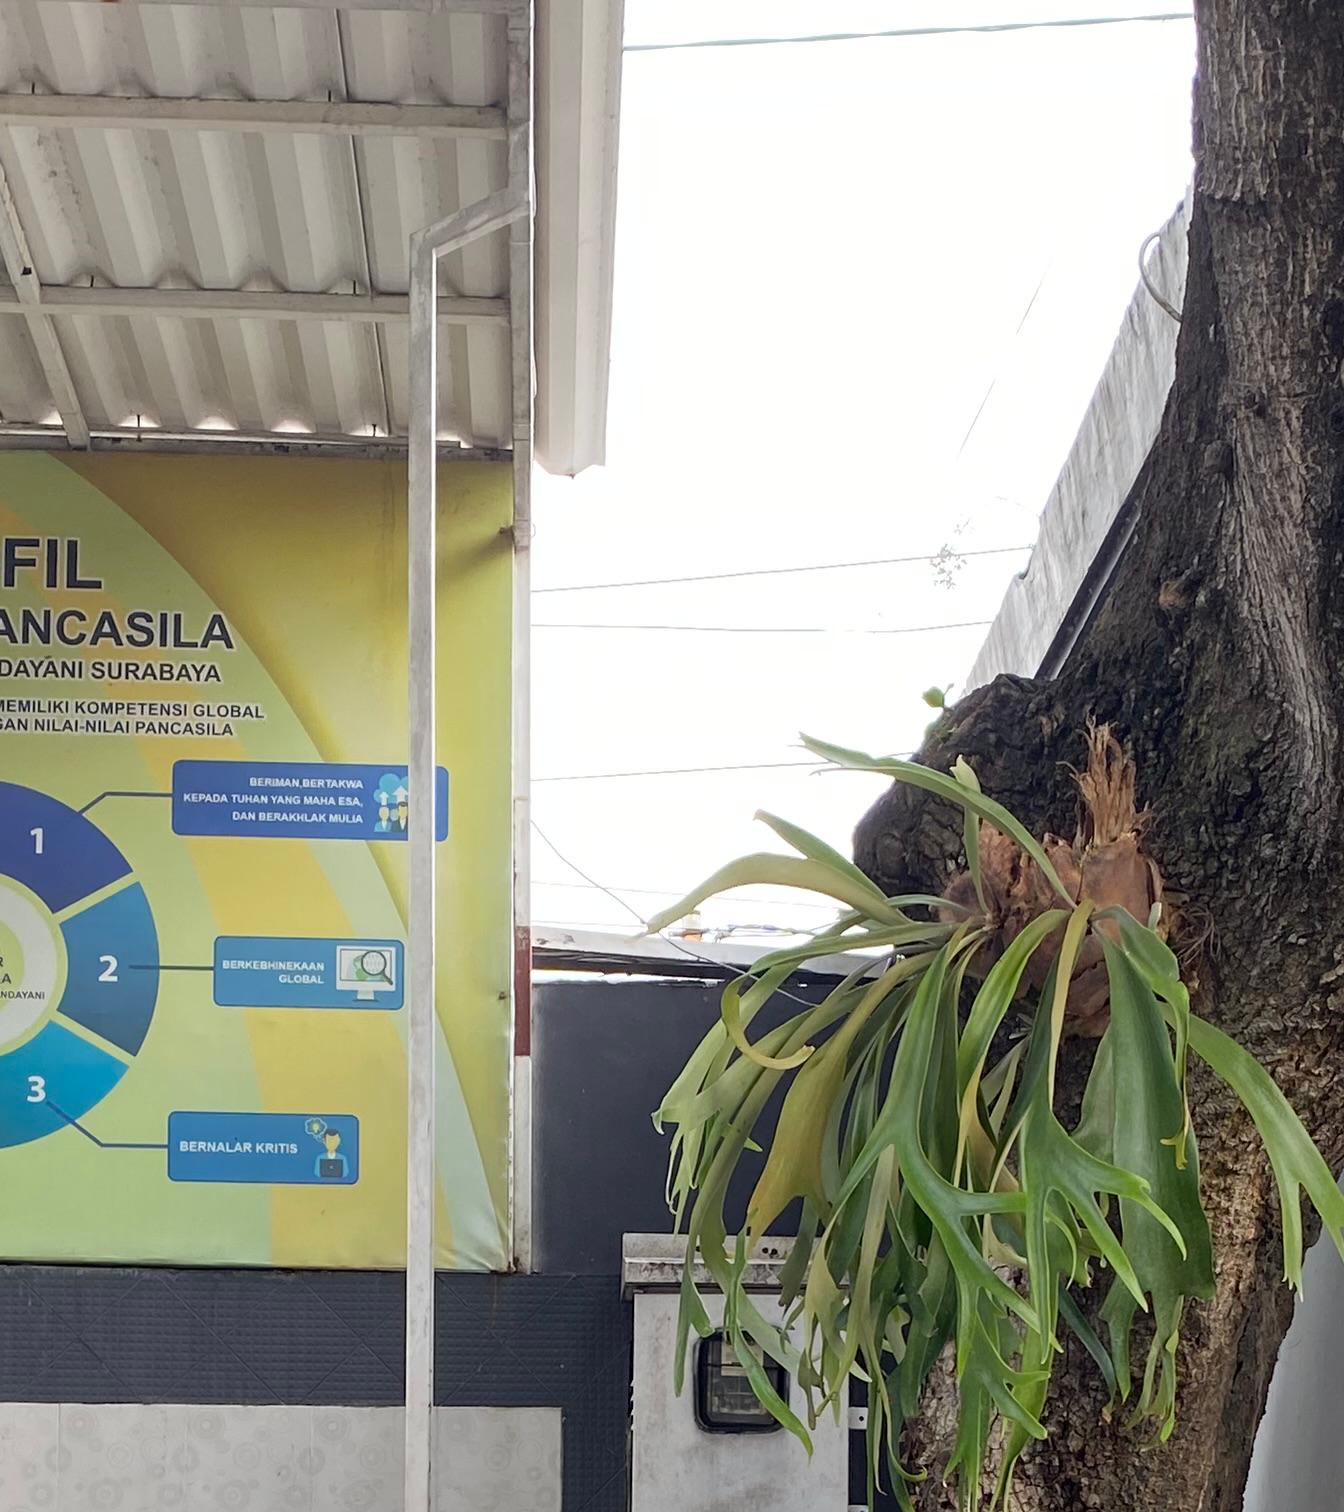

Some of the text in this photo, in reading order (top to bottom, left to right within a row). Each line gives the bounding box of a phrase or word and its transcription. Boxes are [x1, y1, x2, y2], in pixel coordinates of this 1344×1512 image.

[90, 662, 221, 684] SURABAYA
[74, 701, 187, 717] KOMPETENSI
[193, 703, 264, 719] GLOBAL
[33, 718, 130, 734] NILAI-NILAI
[135, 720, 233, 737] PANCASILA
[183, 793, 364, 807] KEPADA TUHAN YANG MAHA ESA,
[232, 811, 364, 824] DAN BERAKHLAK MULIA
[30, 827, 44, 855] 1
[98, 954, 118, 982] 2
[222, 960, 325, 972] BERKEBHINEKAAN
[278, 975, 325, 985] GLOBAL
[27, 1075, 46, 1102] 3
[179, 1141, 298, 1154] BERNALAR KRITIS
